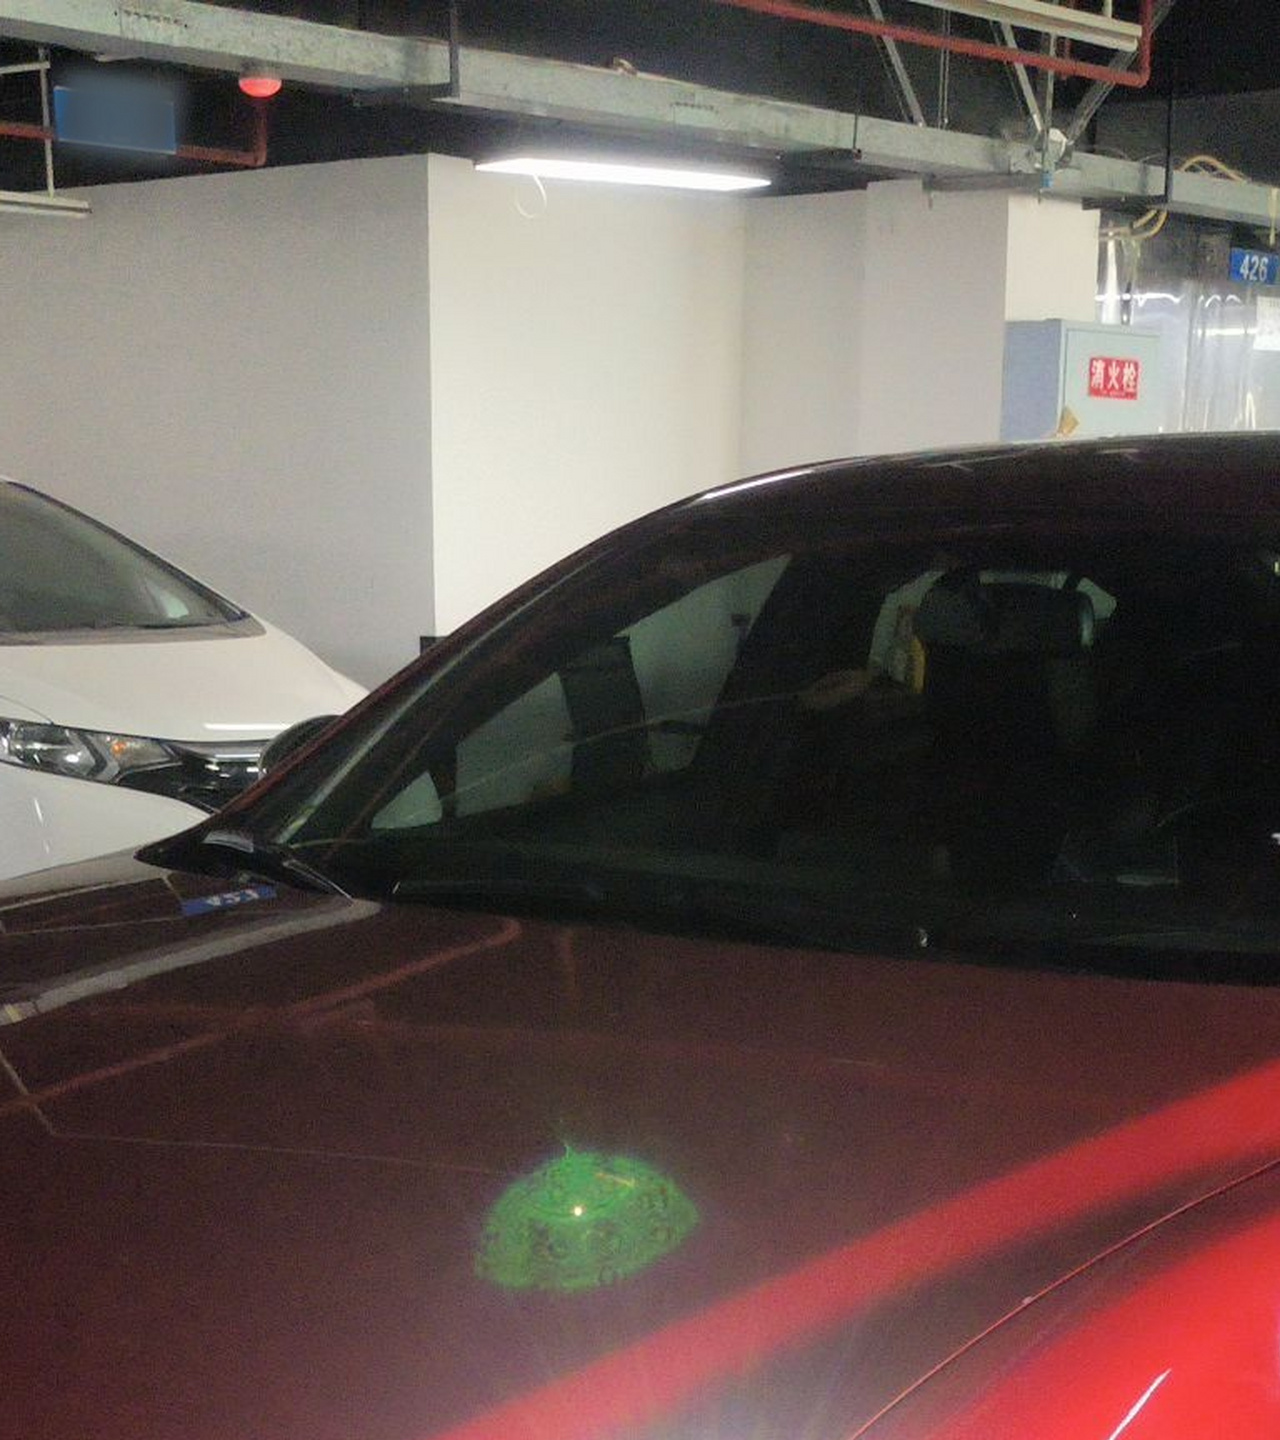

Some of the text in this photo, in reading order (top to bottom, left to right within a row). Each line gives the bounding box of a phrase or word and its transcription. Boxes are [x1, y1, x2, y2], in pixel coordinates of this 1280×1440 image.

[1240, 253, 1269, 281] 426
[1091, 359, 1136, 392] 消火栓
